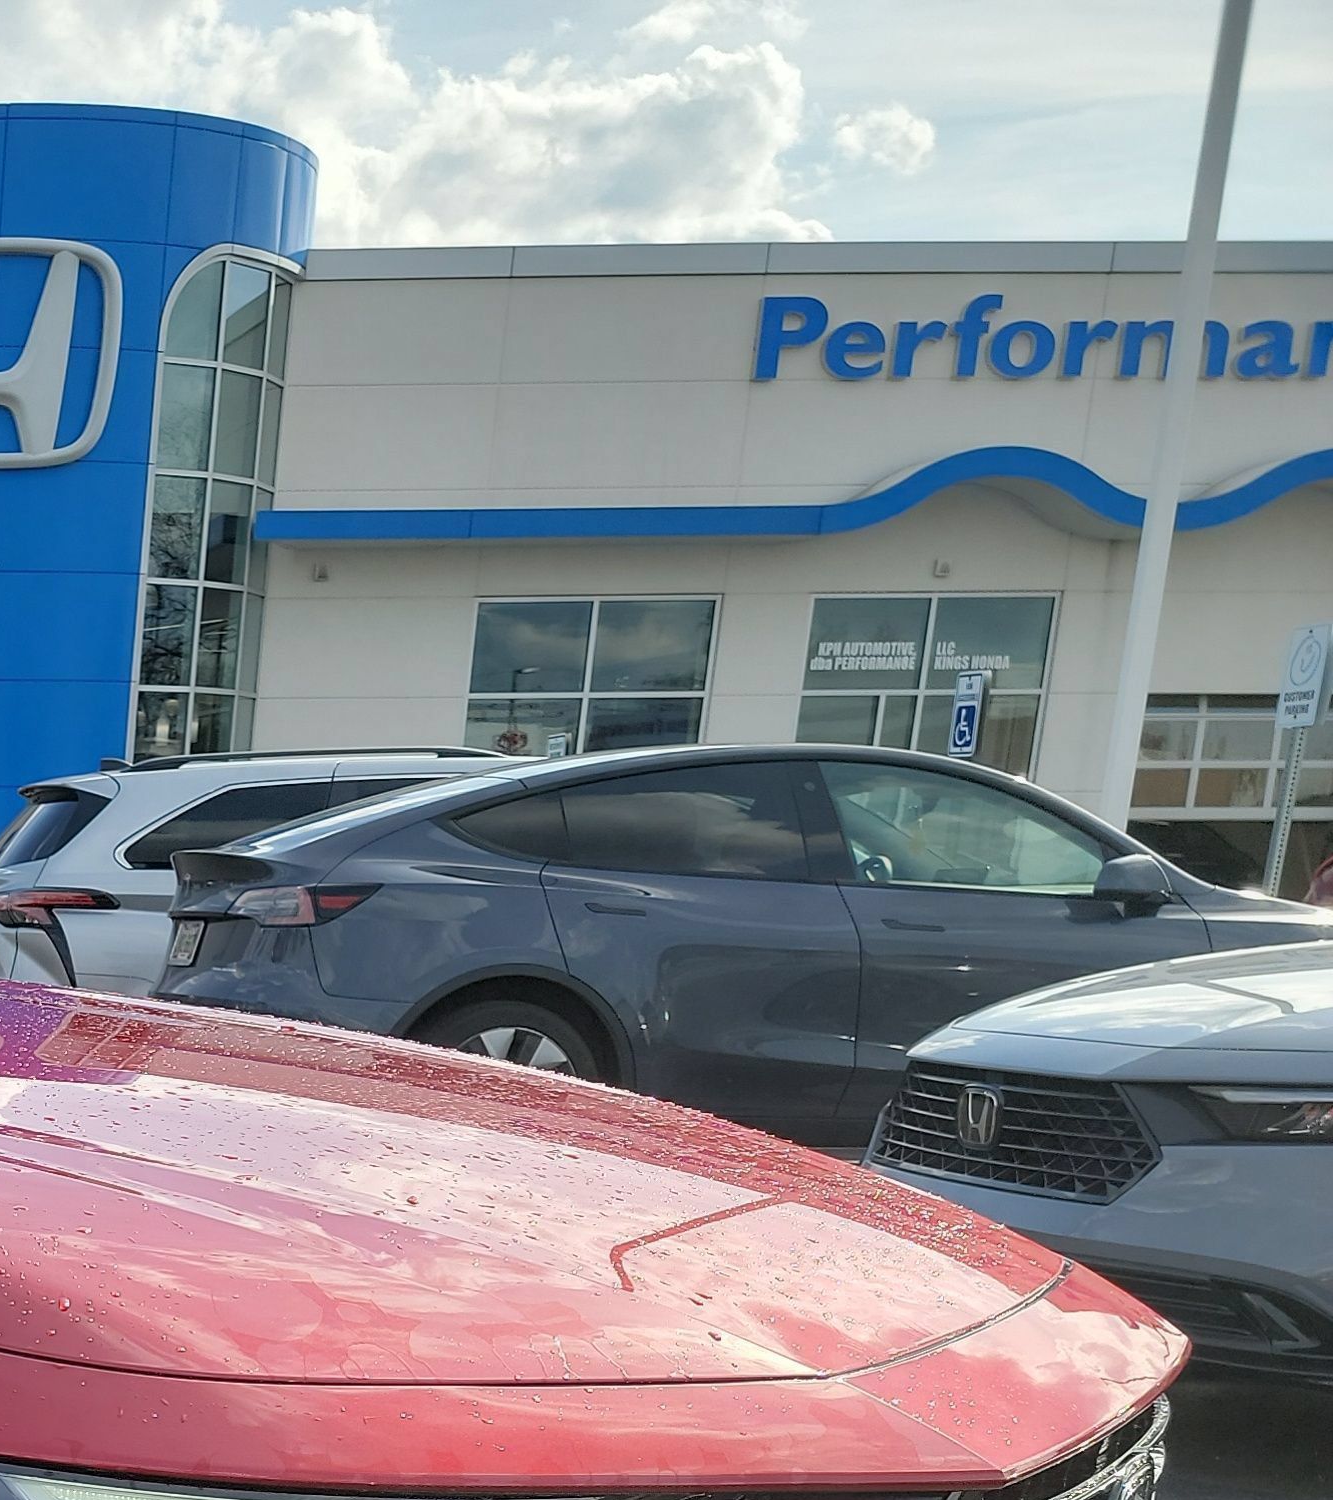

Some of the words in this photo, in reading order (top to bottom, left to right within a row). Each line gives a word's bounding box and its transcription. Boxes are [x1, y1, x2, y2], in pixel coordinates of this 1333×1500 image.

[817, 641, 843, 656] KPH
[936, 641, 956, 654] LLC
[834, 656, 916, 670] PERFORMANCE
[934, 655, 970, 669] KINGS
[971, 655, 1011, 670] HONDA
